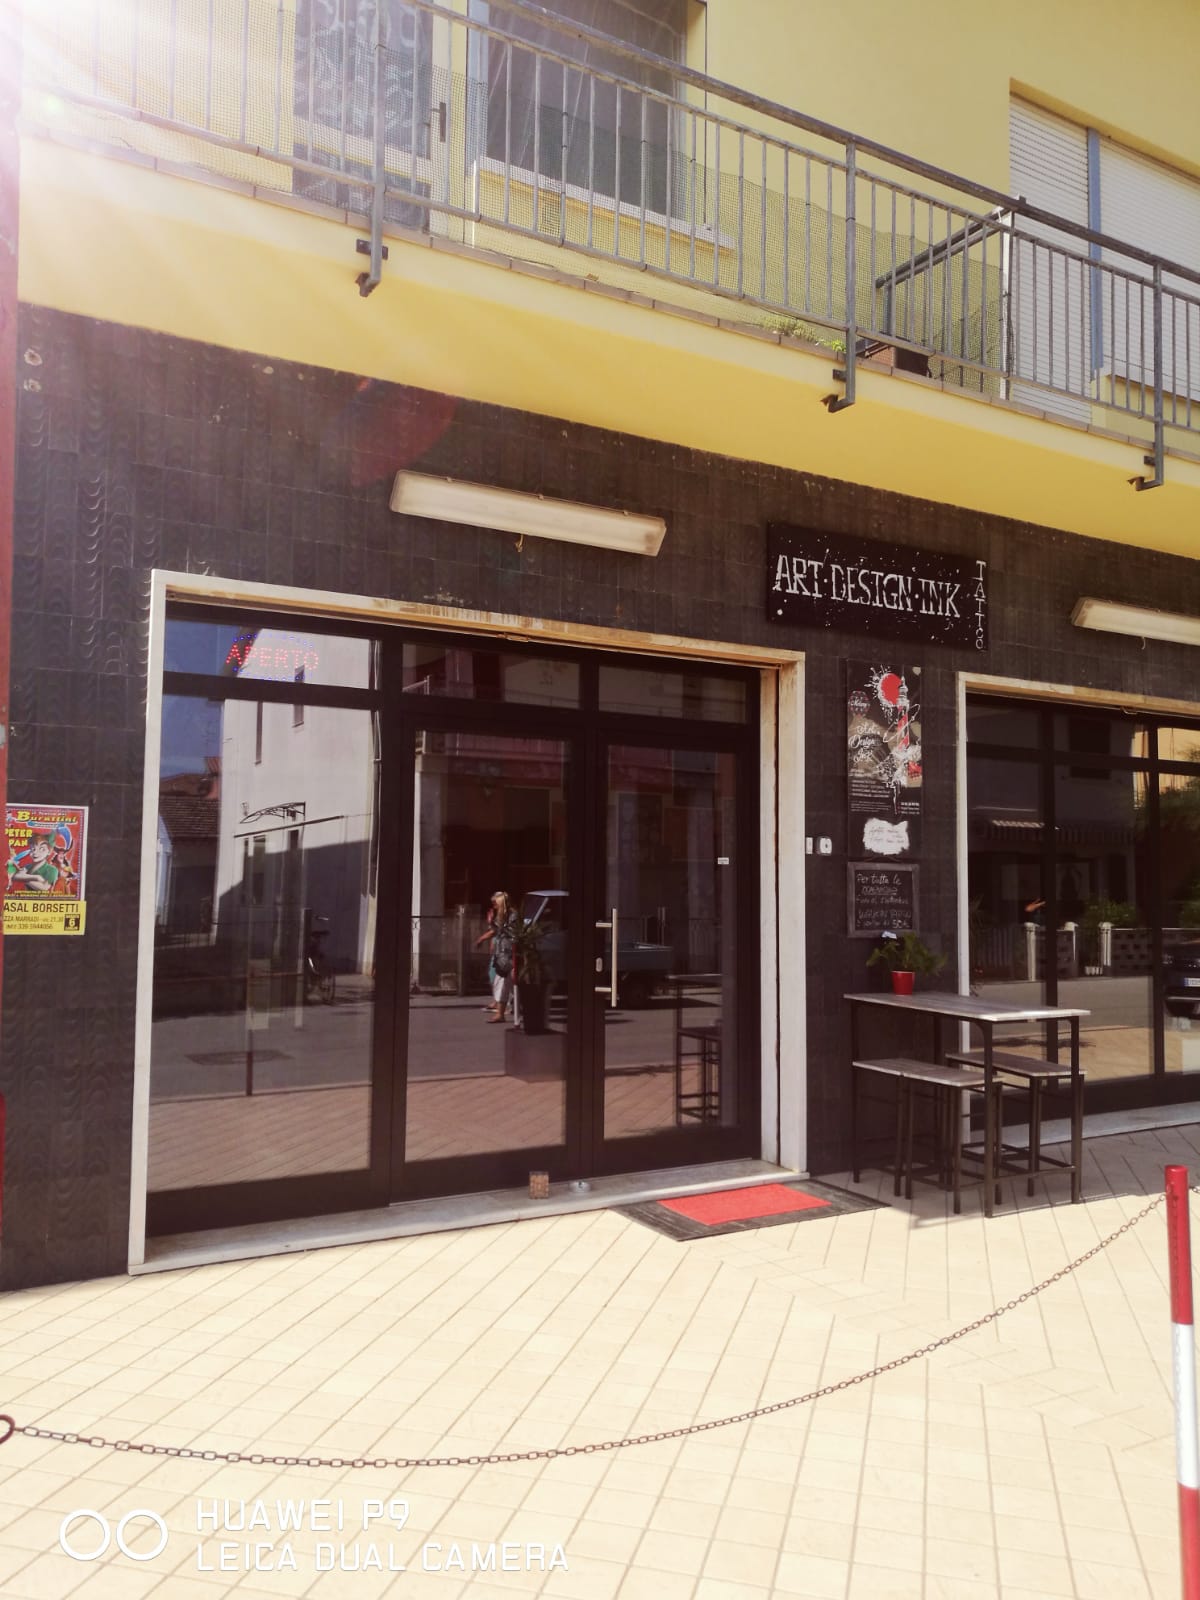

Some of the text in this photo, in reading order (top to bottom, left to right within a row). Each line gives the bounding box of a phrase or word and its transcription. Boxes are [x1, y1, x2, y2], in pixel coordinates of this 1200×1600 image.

[772, 554, 961, 618] ART DESIGN INK
[974, 560, 987, 650] TATTOO
[225, 643, 320, 671] APERTO
[17, 810, 78, 823] Burattini
[8, 839, 28, 848] PAN
[32, 902, 79, 913] BORSETTI
[68, 916, 76, 928] 6
